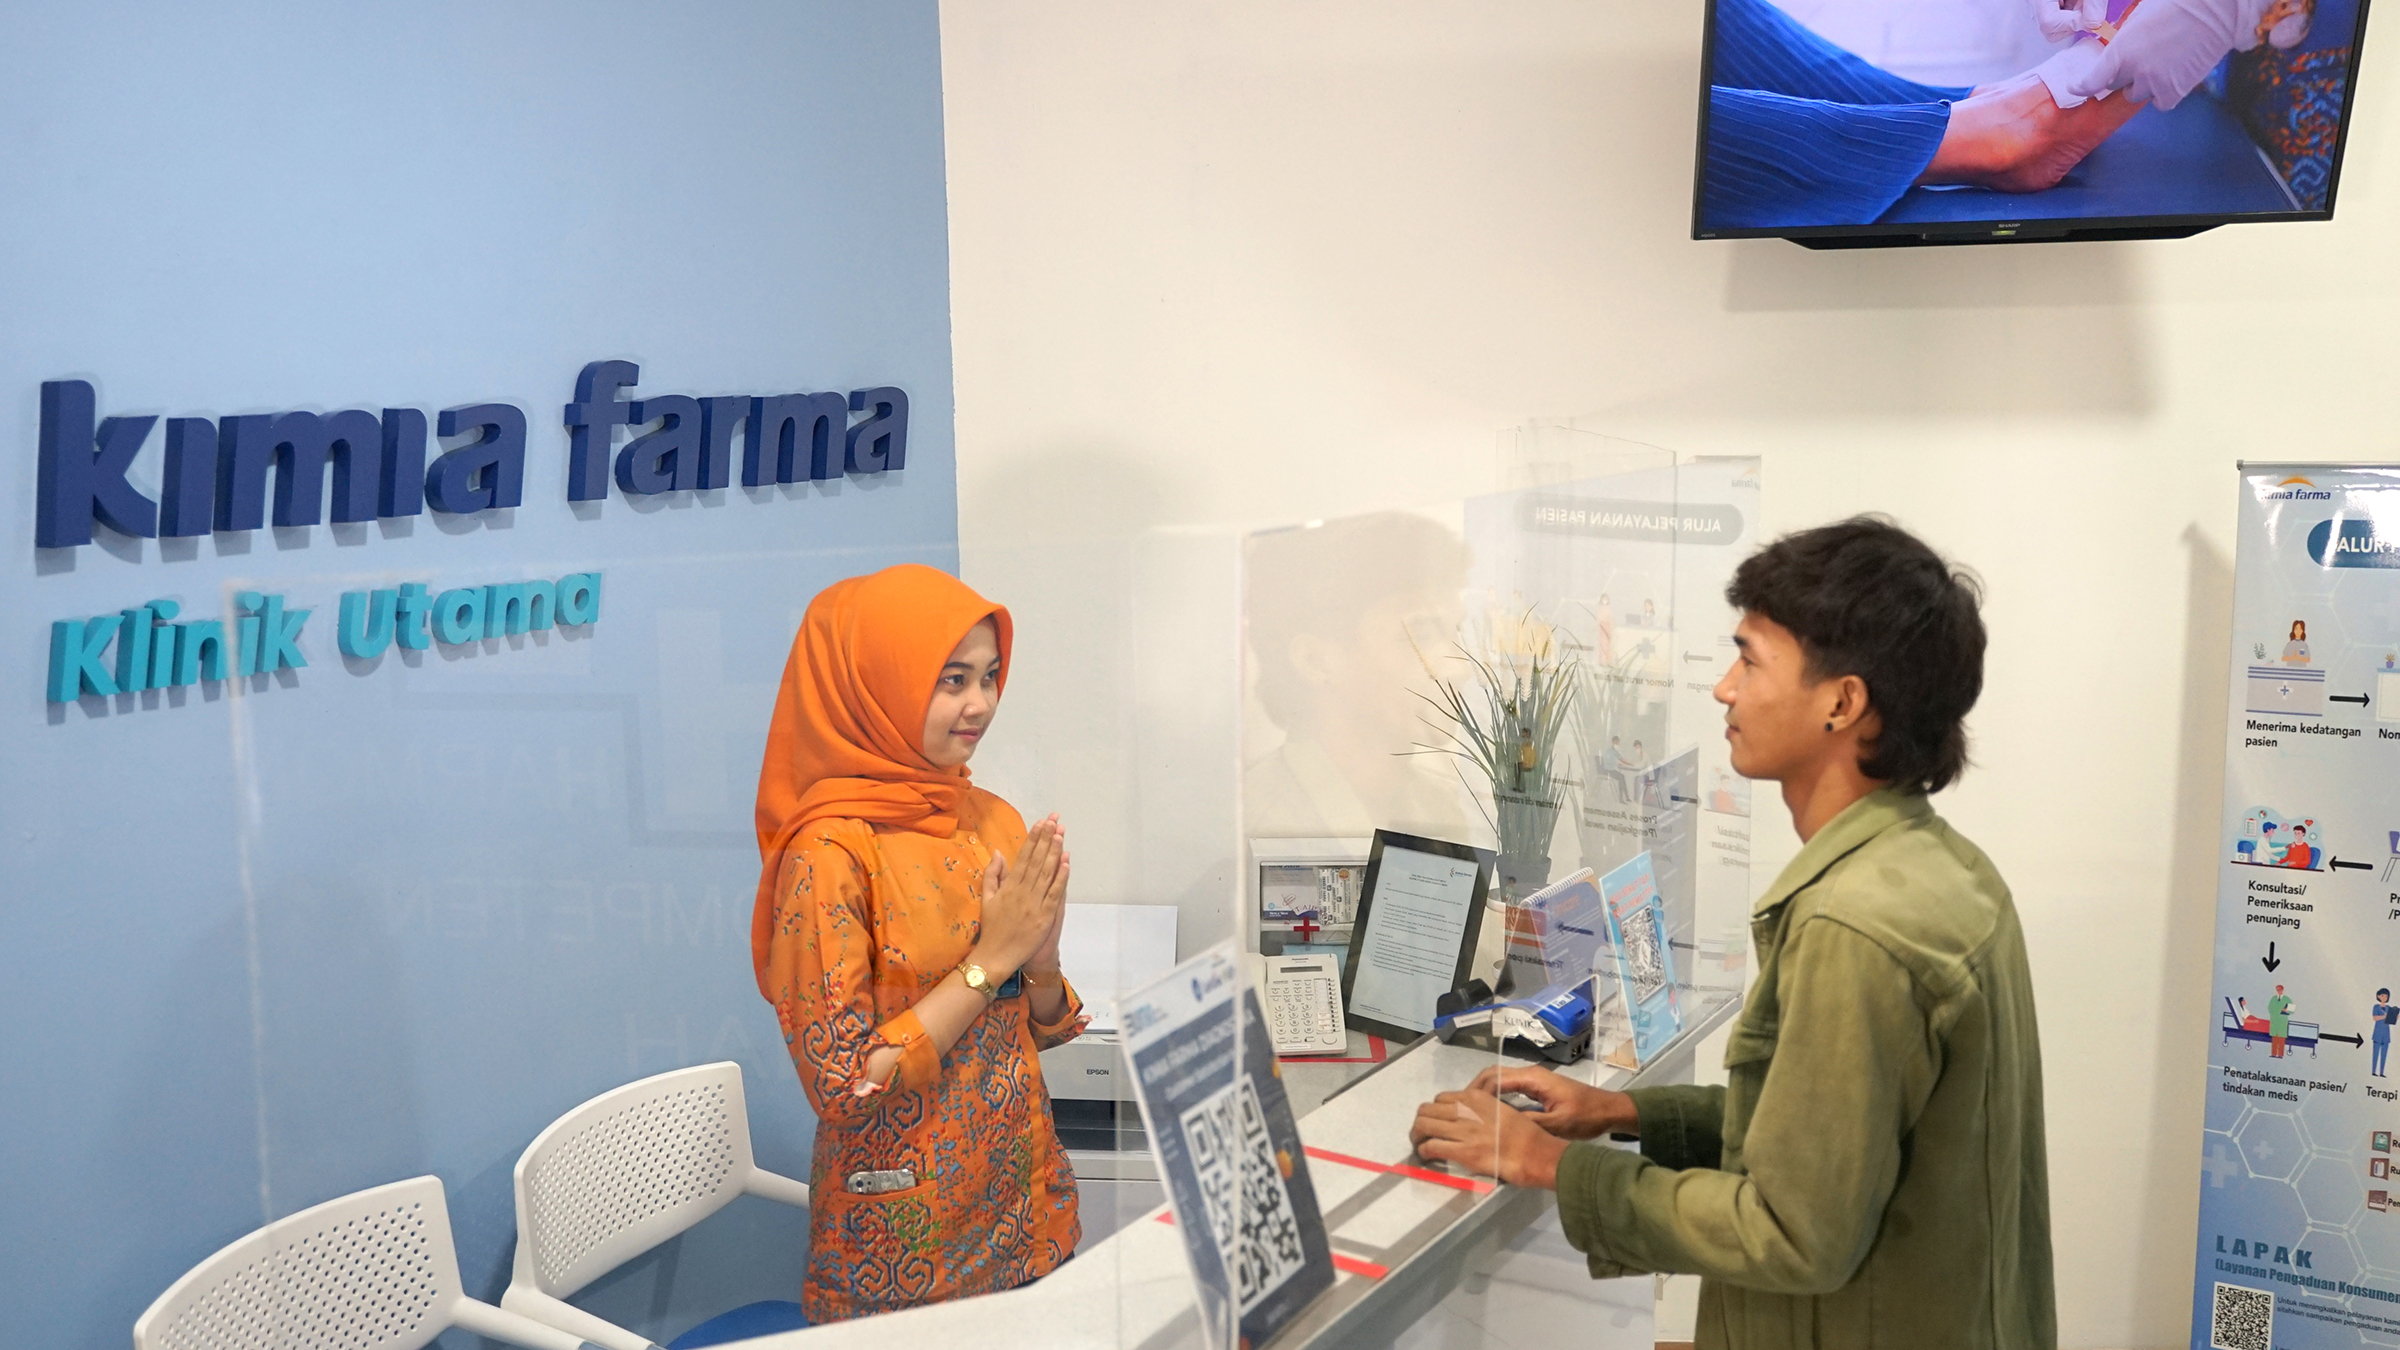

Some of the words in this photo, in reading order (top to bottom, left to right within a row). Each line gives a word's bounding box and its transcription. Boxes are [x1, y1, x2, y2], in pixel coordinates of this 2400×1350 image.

[36, 380, 527, 548] kimia
[565, 359, 910, 502] farma
[2295, 489, 2331, 500] farma
[2337, 537, 2385, 553] ALUR
[47, 592, 310, 703] Klinik
[337, 572, 603, 660] Utama
[2246, 720, 2297, 734] Menerima
[2300, 723, 2361, 738] kedatangan
[2245, 736, 2278, 749] pasien
[2248, 880, 2307, 896] Konsultasi/
[2247, 896, 2313, 912] Pemeriksaan
[2246, 913, 2301, 929] penunjang
[2223, 1066, 2306, 1088] Penatalaksanaan
[2309, 1080, 2348, 1094] pasien/
[2222, 1082, 2266, 1098] tindakan
[2267, 1088, 2298, 1102] medis
[2366, 1086, 2398, 1102] Terapi
[2216, 1235, 2313, 1269] LAPAK
[2214, 1258, 2268, 1279] (Layanan
[2269, 1267, 2337, 1291] Pengaduan
[2338, 1280, 2400, 1305] Konsumen
[2277, 1297, 2298, 1307] Untuk
[2298, 1301, 2346, 1316] meningkatkan
[2347, 1310, 2383, 1323] pelayanan
[2305, 1311, 2343, 1324] sampaikan
[2343, 1319, 2383, 1332] pengaduan
